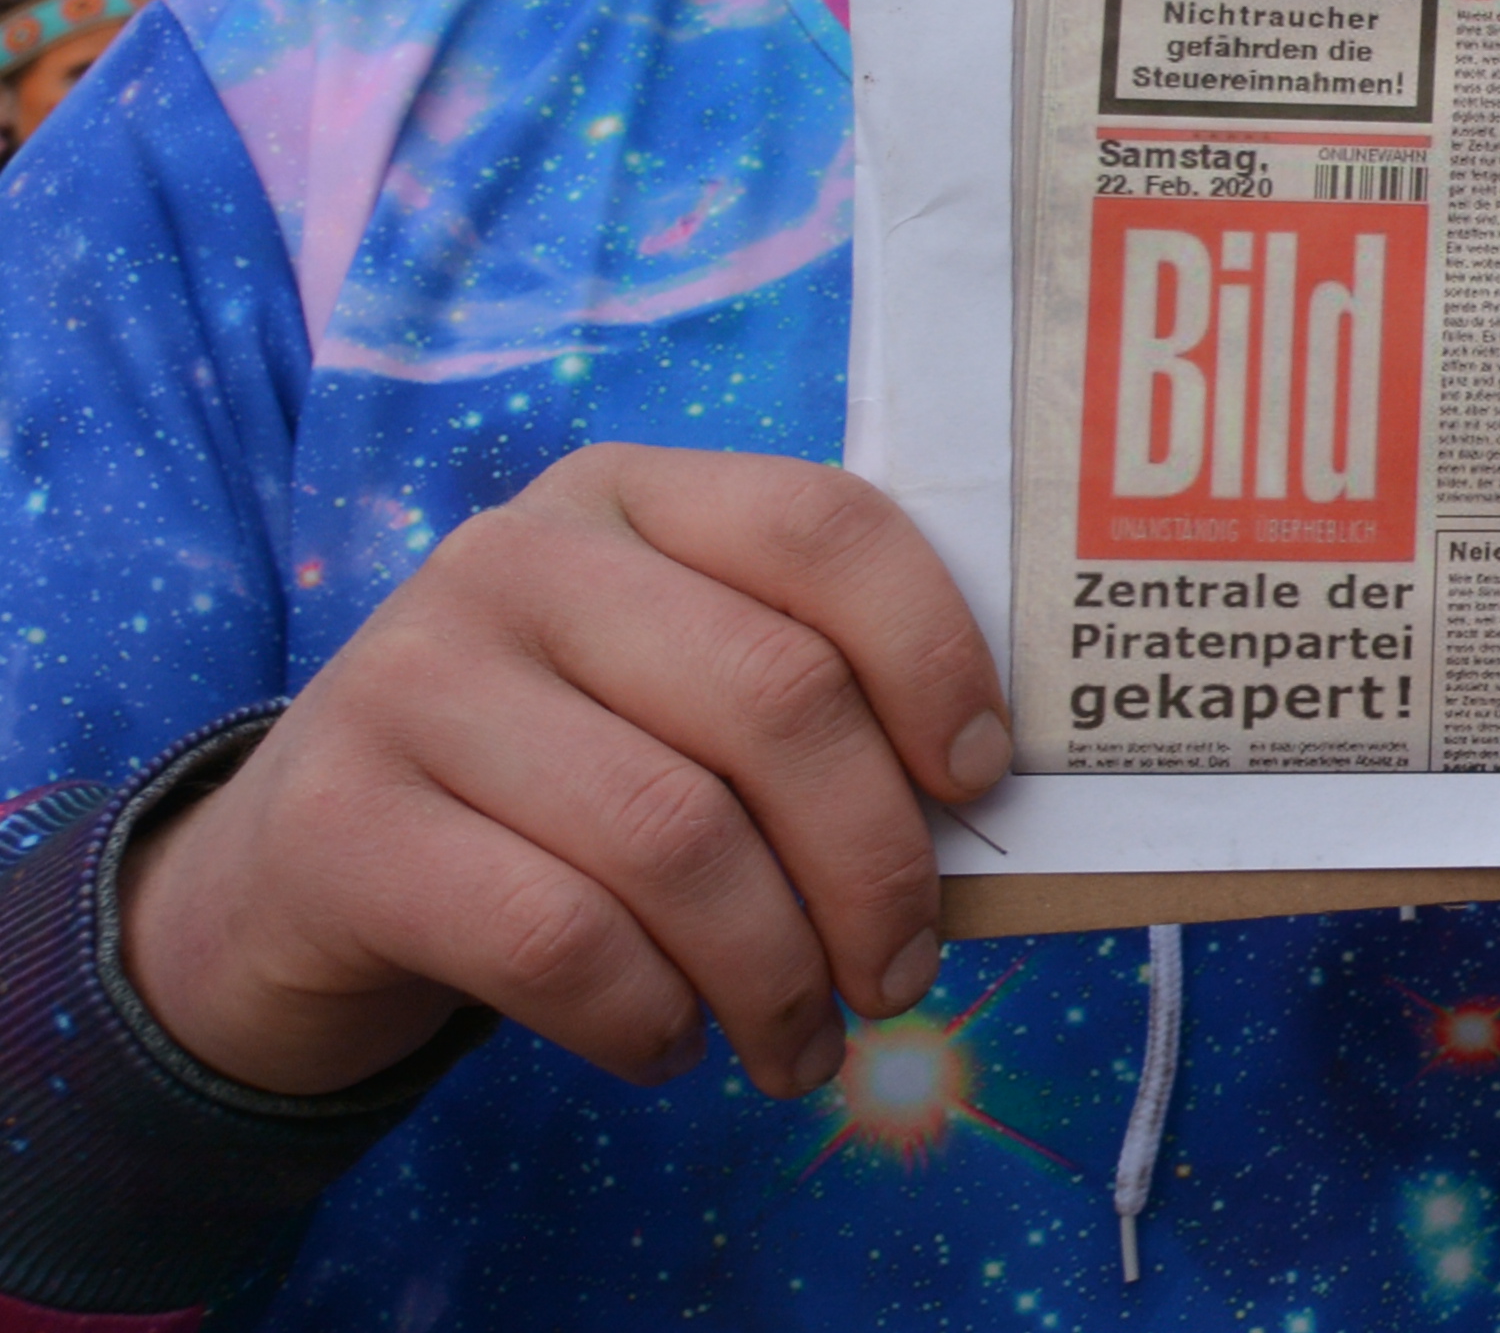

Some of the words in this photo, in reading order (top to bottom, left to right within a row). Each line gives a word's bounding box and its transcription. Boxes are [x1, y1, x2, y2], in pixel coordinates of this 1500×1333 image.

[1165, 1, 1379, 29] Nichtraucher
[1168, 35, 1317, 63] gefährden
[1329, 40, 1372, 61] die
[1133, 66, 1402, 94] Steuereinnahmen!
[1100, 140, 1269, 178] Samstag,
[1318, 147, 1427, 163] ONLINEWAHN
[1097, 175, 1133, 195] 22.
[1146, 176, 1199, 196] Feb.
[1210, 177, 1273, 198] 2020
[1114, 229, 1385, 501] Bild
[1254, 517, 1378, 543] ÜBERHEBLICH
[1075, 573, 1299, 608] Zentrale
[1327, 574, 1413, 609] der
[1073, 624, 1412, 667] Piratenpartei
[1071, 673, 1411, 730] gekapert!
